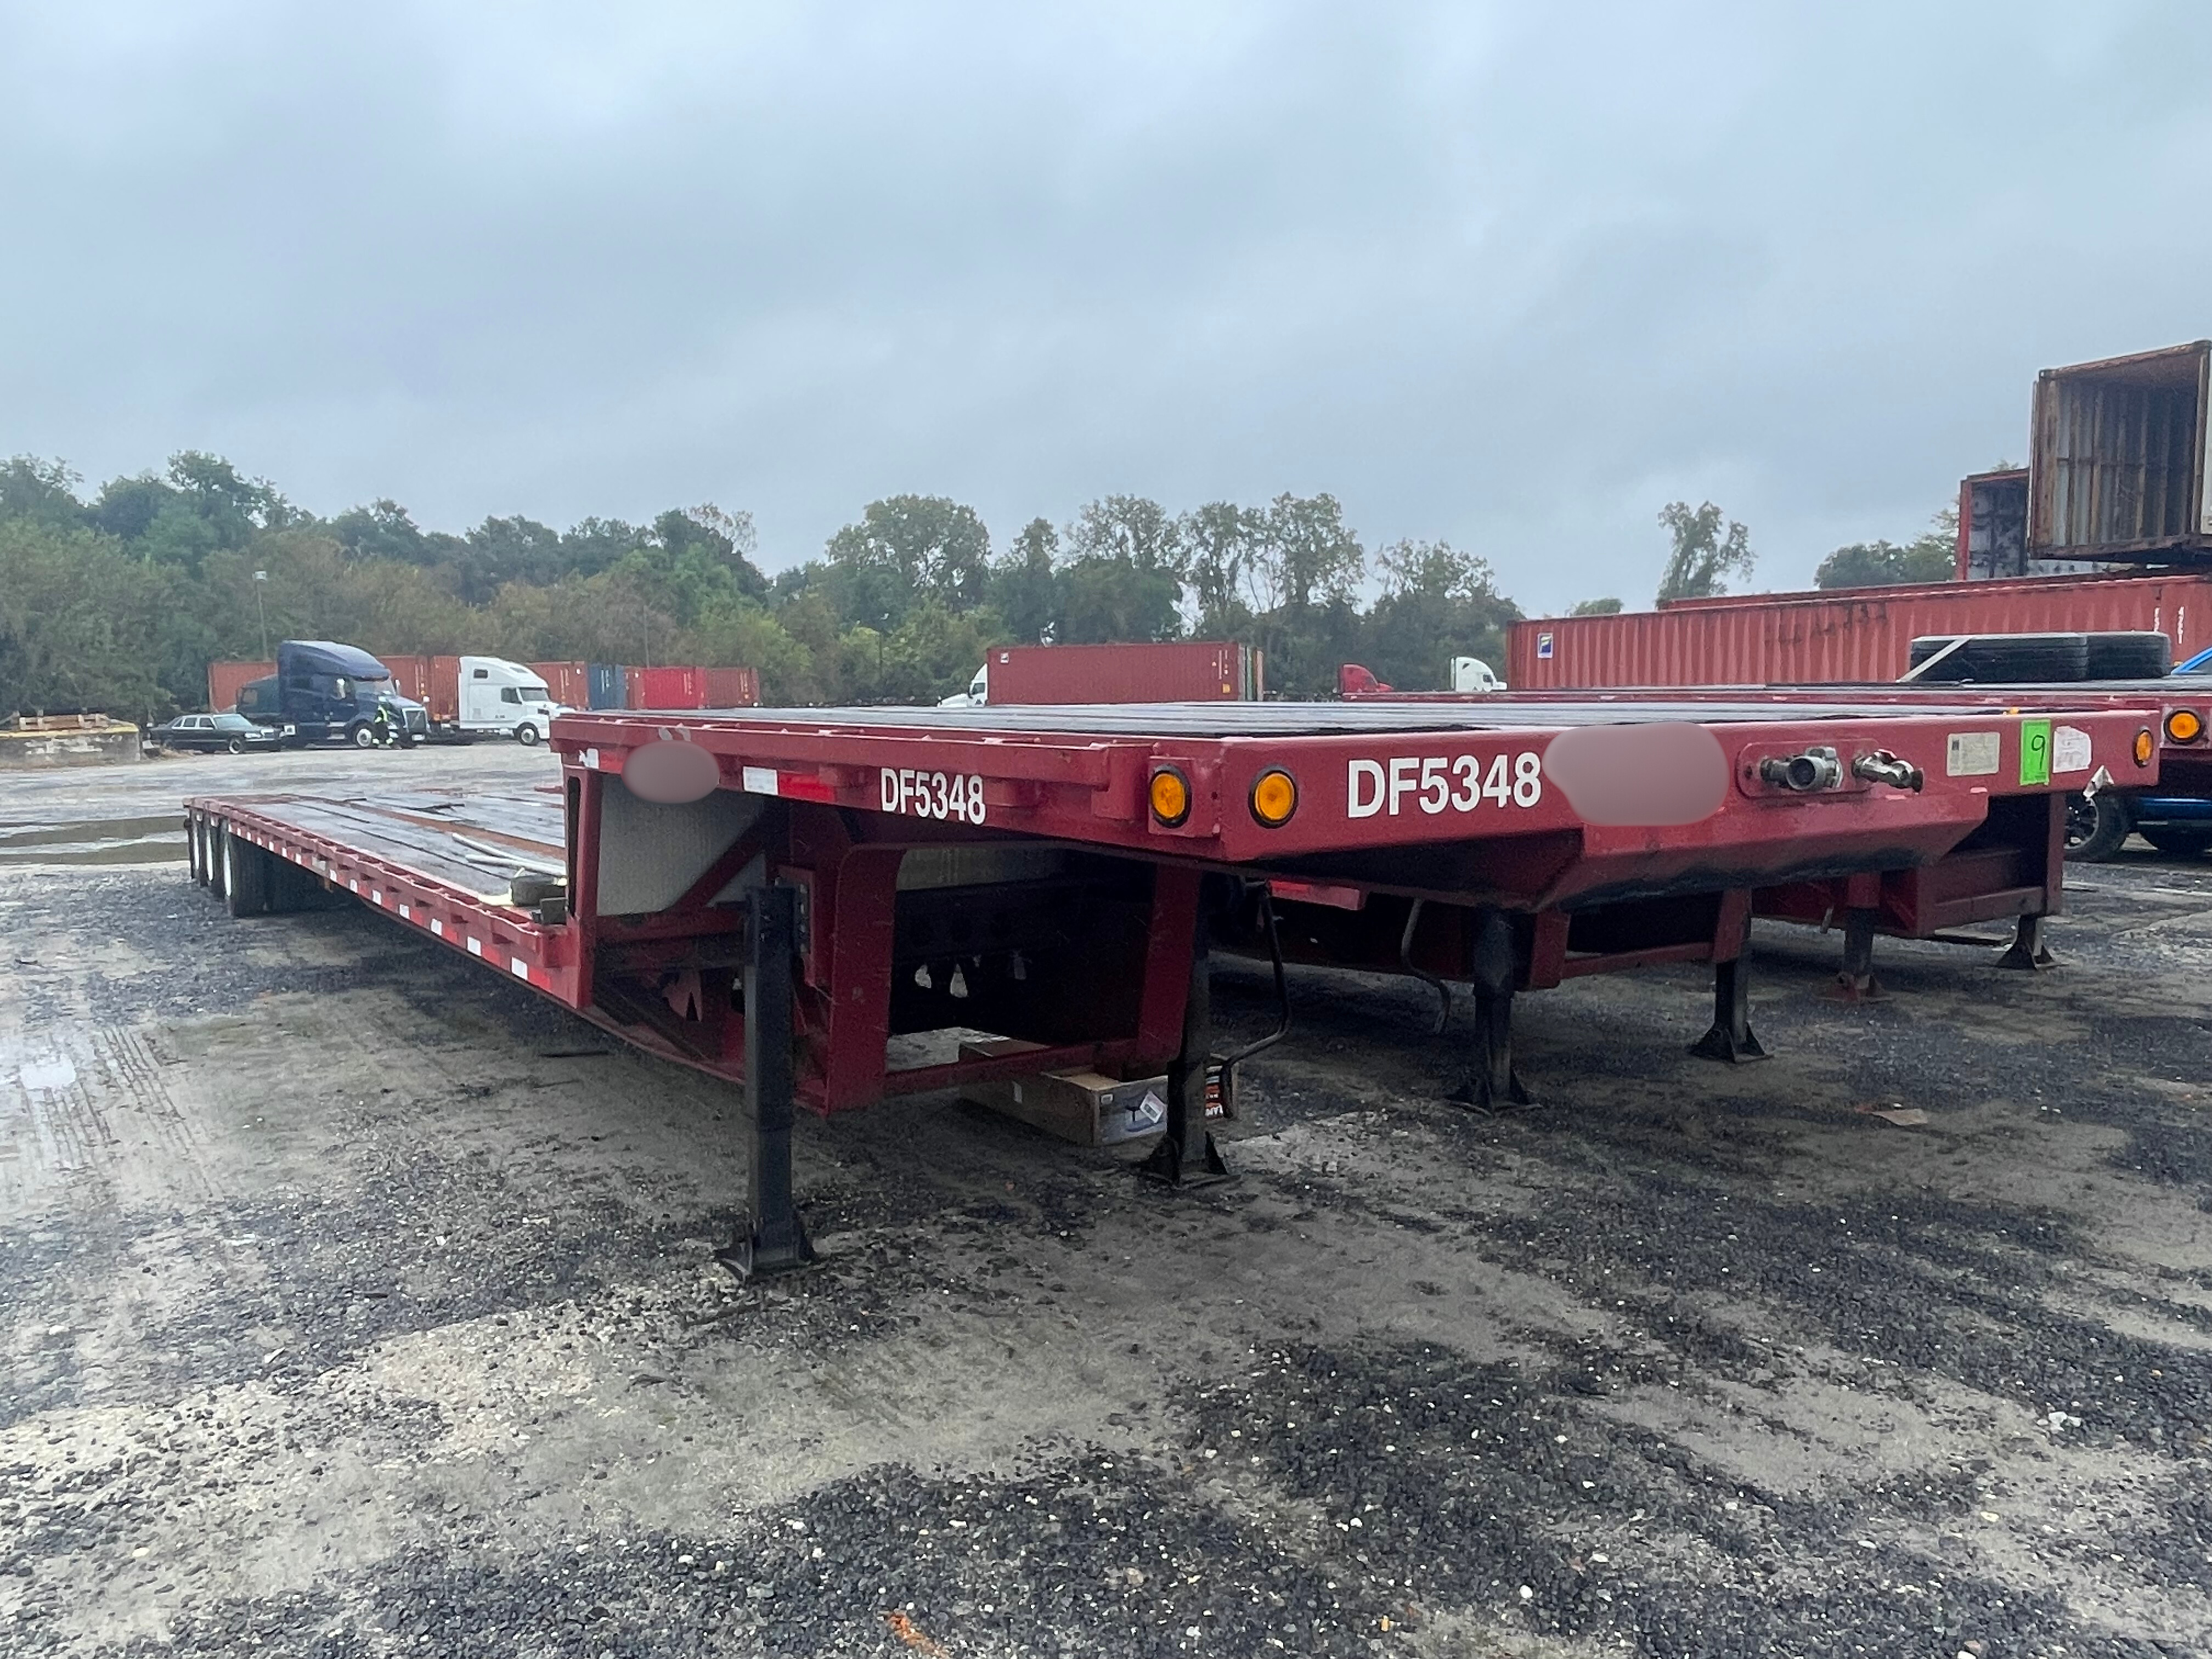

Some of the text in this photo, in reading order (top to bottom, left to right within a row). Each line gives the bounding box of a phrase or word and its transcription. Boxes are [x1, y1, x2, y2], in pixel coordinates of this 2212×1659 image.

[2031, 735, 2045, 771] 9
[881, 768, 986, 825] DF5348
[1348, 752, 1542, 818] DF5348
